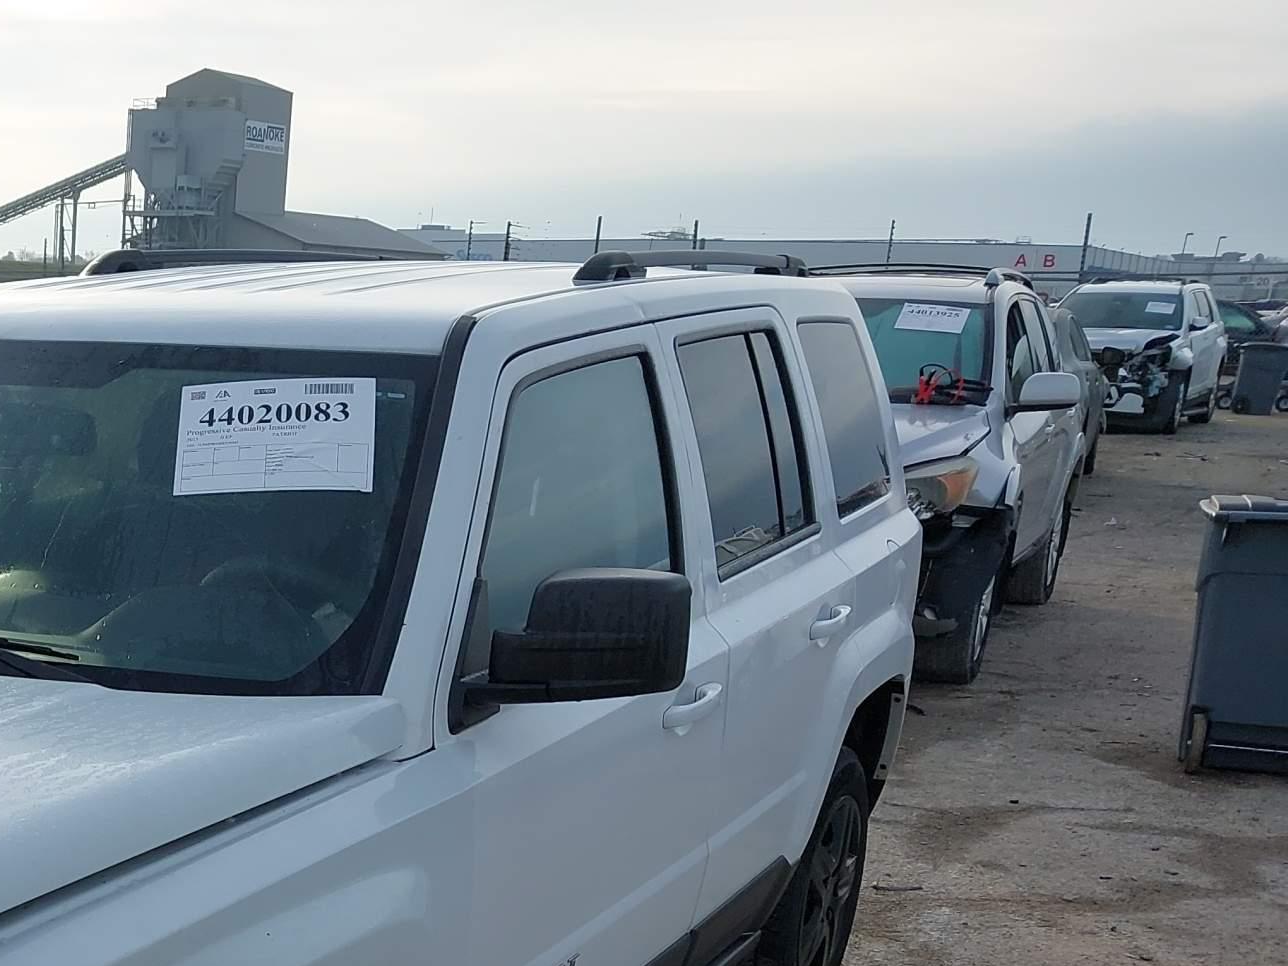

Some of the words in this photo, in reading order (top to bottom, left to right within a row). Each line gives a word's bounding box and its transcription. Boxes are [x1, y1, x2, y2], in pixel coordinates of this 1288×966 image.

[246, 125, 285, 142] ROANOKE
[1014, 253, 1027, 267] A
[1043, 254, 1056, 268] B
[199, 401, 350, 428] 44020083
[268, 423, 307, 431] Insurance
